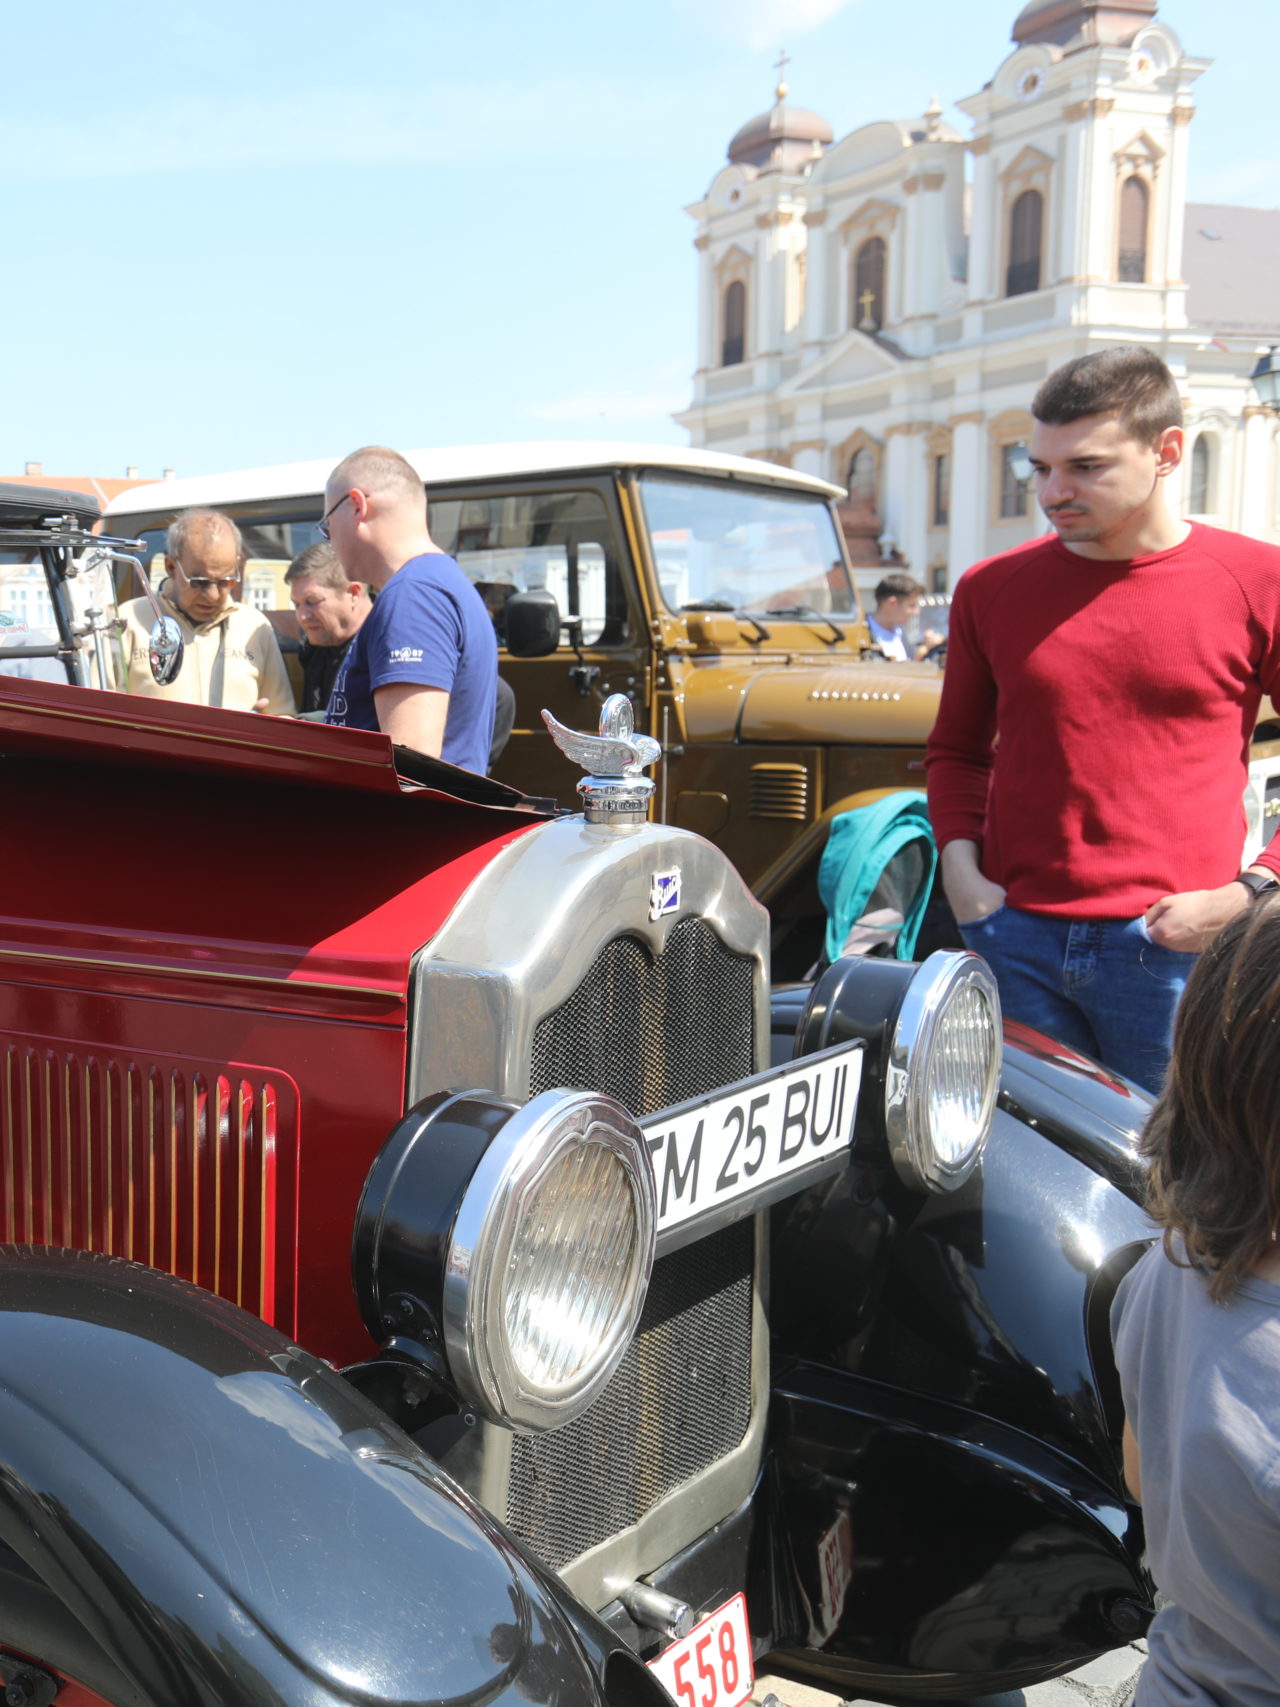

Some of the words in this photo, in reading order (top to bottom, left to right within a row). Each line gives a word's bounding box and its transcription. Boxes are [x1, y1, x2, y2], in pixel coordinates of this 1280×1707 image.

[715, 1093, 770, 1193] 25
[778, 1064, 848, 1163] BUI
[673, 1620, 740, 1707] 558
